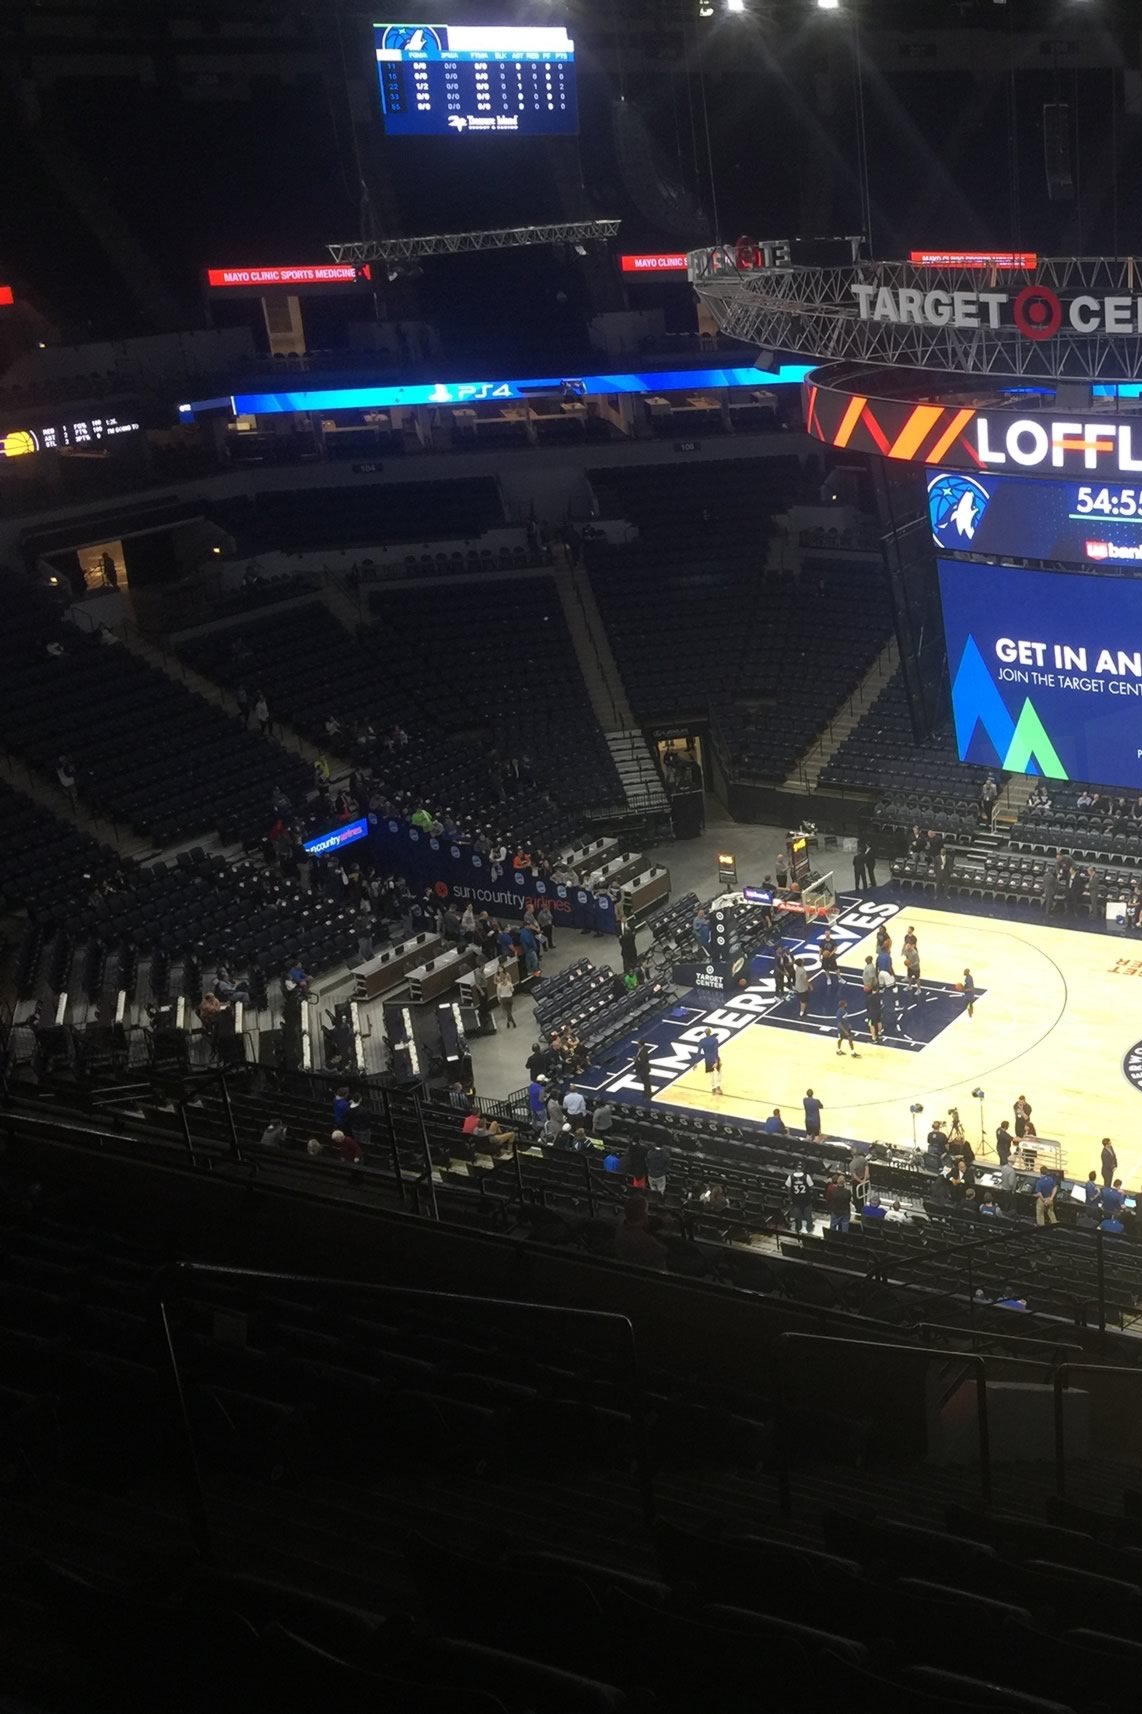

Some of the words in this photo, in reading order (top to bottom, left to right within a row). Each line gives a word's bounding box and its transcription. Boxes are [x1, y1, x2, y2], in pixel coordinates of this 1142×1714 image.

[635, 258, 657, 268] MAYO
[658, 257, 683, 267] CLINIC
[224, 272, 249, 282] MAYO
[251, 271, 279, 281] CLINIC
[281, 270, 313, 279] SPORTS
[316, 268, 356, 279] MEDICINE
[851, 283, 1008, 329] TARGET
[458, 384, 513, 400] PS4
[995, 638, 1047, 667] GET
[1054, 644, 1087, 672] IN
[998, 667, 1029, 684] JOIN
[1031, 672, 1055, 687] THE
[1058, 674, 1105, 693] TARGET
[695, 972, 724, 983] TARGET
[695, 979, 724, 989] CENTER
[793, 1185, 806, 1195] 32
